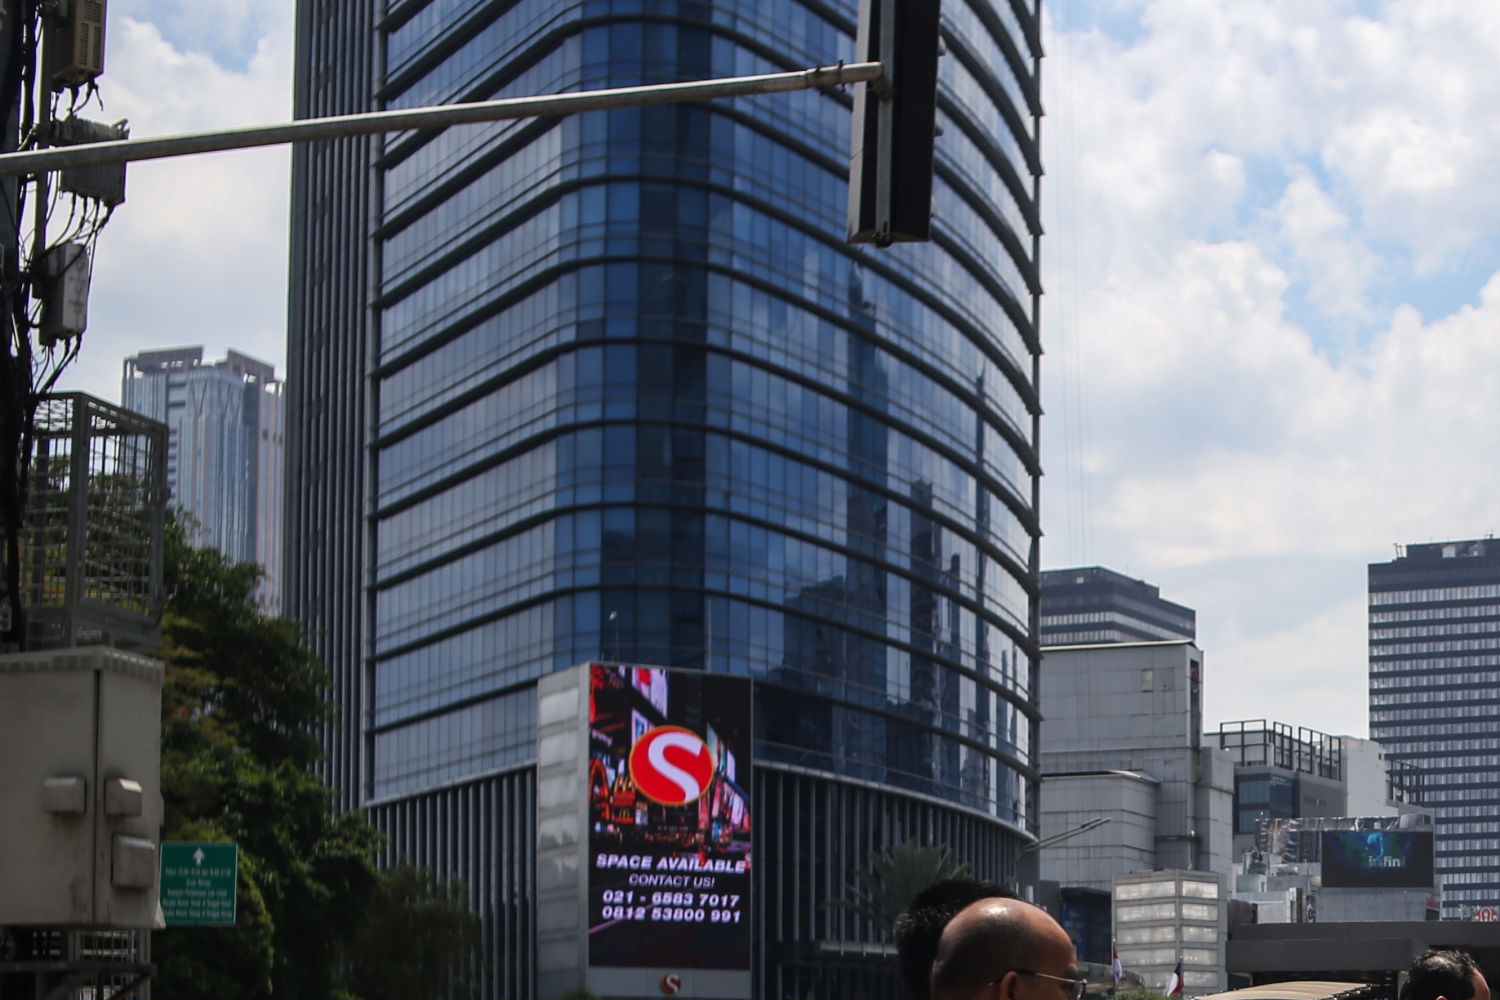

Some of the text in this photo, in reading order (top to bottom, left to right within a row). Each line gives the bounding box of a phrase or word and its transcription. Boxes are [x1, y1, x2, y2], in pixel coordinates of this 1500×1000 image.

[596, 853, 746, 873] SPACE AVAILABLE
[629, 873, 716, 888] CONTACT US!
[603, 890, 634, 903] 021
[652, 891, 693, 906] 6583
[699, 894, 740, 907] 7017
[602, 906, 741, 923] 0812 53800 991
